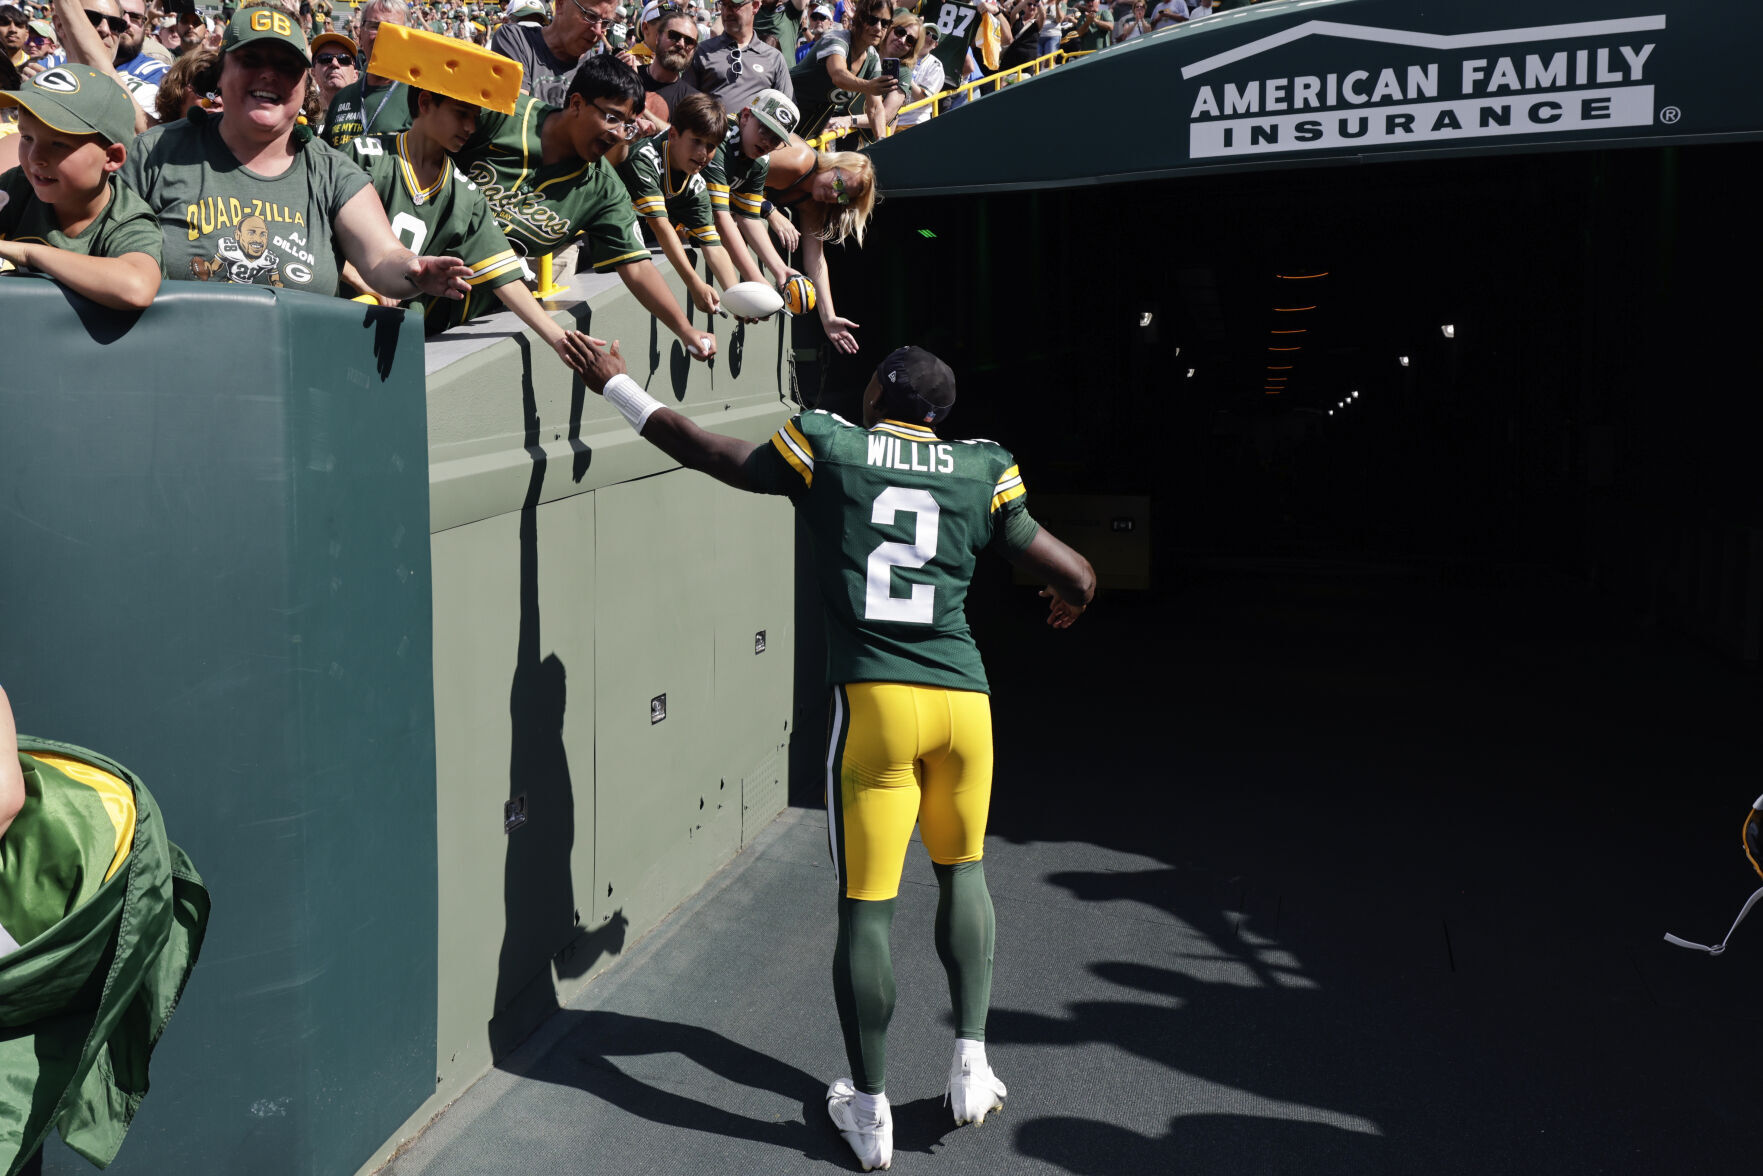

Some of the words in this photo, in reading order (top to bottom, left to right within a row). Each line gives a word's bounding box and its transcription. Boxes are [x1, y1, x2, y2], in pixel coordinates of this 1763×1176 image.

[251, 10, 292, 37] GB
[936, 3, 976, 38] 87
[1190, 63, 1438, 118] AMERICAN
[1462, 44, 1656, 94] FAMILY
[1223, 97, 1612, 148] INSURANCE
[187, 196, 305, 241] QUAD-ZILLA
[289, 231, 306, 246] AJ
[273, 235, 315, 266] DILLON
[867, 434, 954, 474] WILLIS
[864, 486, 940, 625] 2
